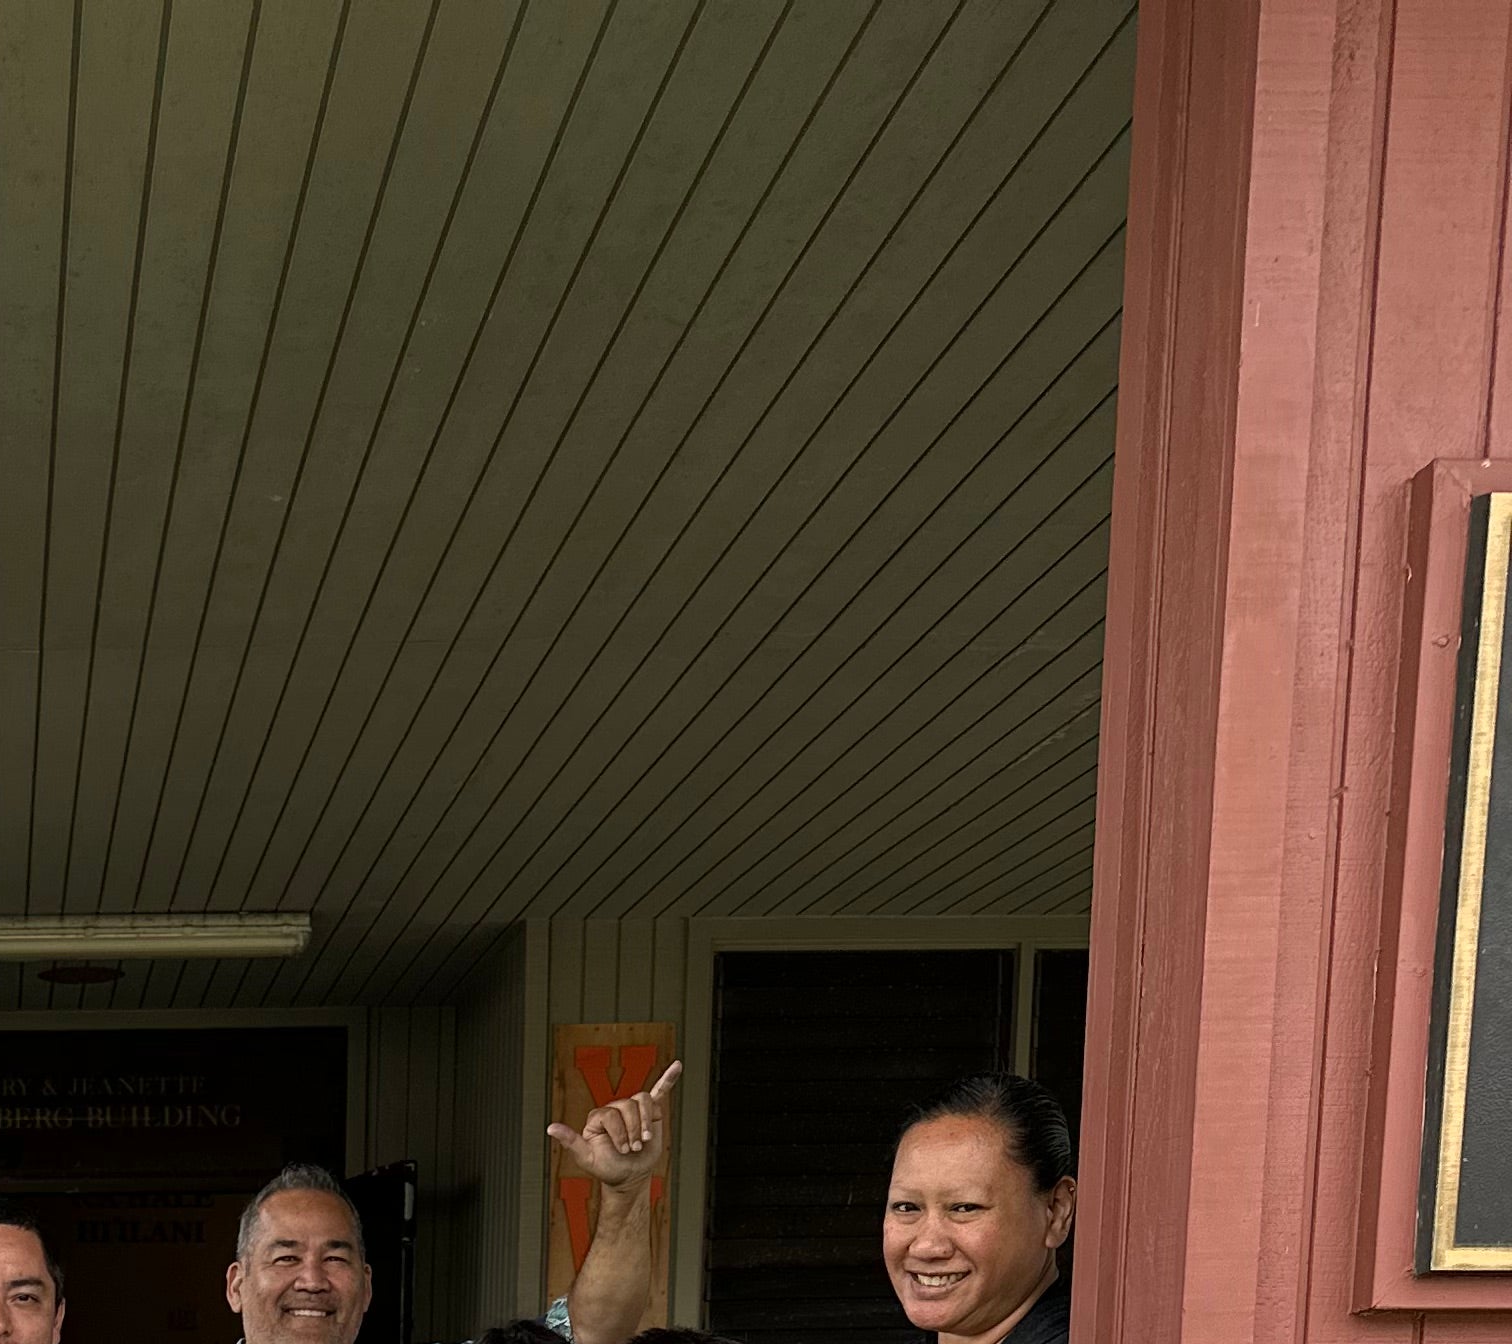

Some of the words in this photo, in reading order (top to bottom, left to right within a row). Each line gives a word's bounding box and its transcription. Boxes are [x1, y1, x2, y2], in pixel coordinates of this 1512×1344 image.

[40, 1078, 58, 1097] &
[70, 1077, 208, 1097] JEANETTE
[87, 1105, 242, 1128] BUILDING
